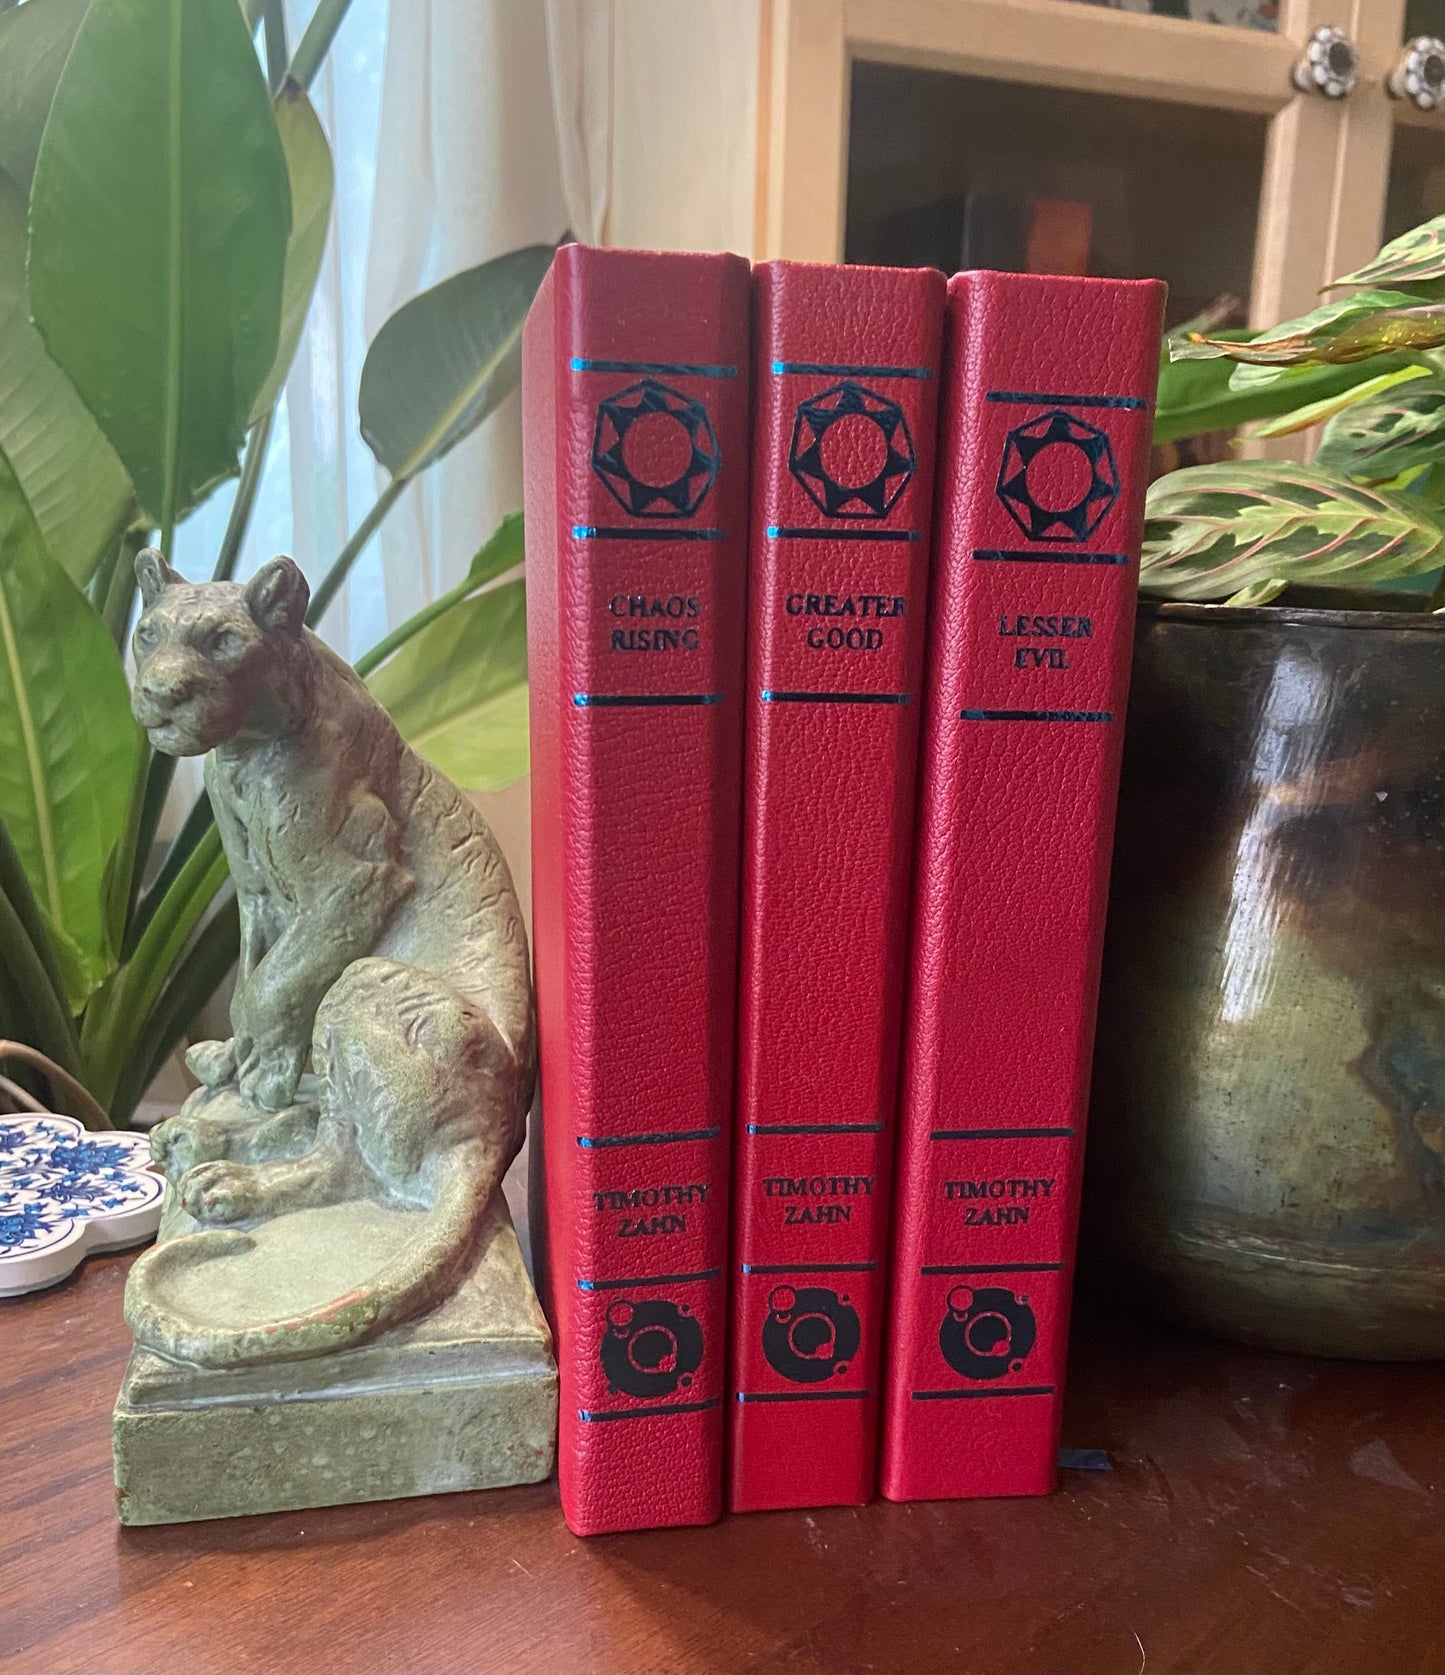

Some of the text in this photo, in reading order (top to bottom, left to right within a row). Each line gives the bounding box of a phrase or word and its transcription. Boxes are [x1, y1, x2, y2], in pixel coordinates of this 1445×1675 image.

[609, 594, 700, 618] CHAOS
[786, 594, 907, 618] GREATER
[1000, 614, 1093, 639] LESSER
[610, 628, 700, 651] RISING
[806, 627, 884, 650] GOOD
[593, 1183, 710, 1211] TIMOTHY
[763, 1176, 876, 1198] TIMOTHY
[945, 1178, 1056, 1200] TIMOTHY
[785, 1204, 852, 1225] ZAHN
[964, 1206, 1031, 1228] ZAHN
[617, 1214, 688, 1239] ZAHN
